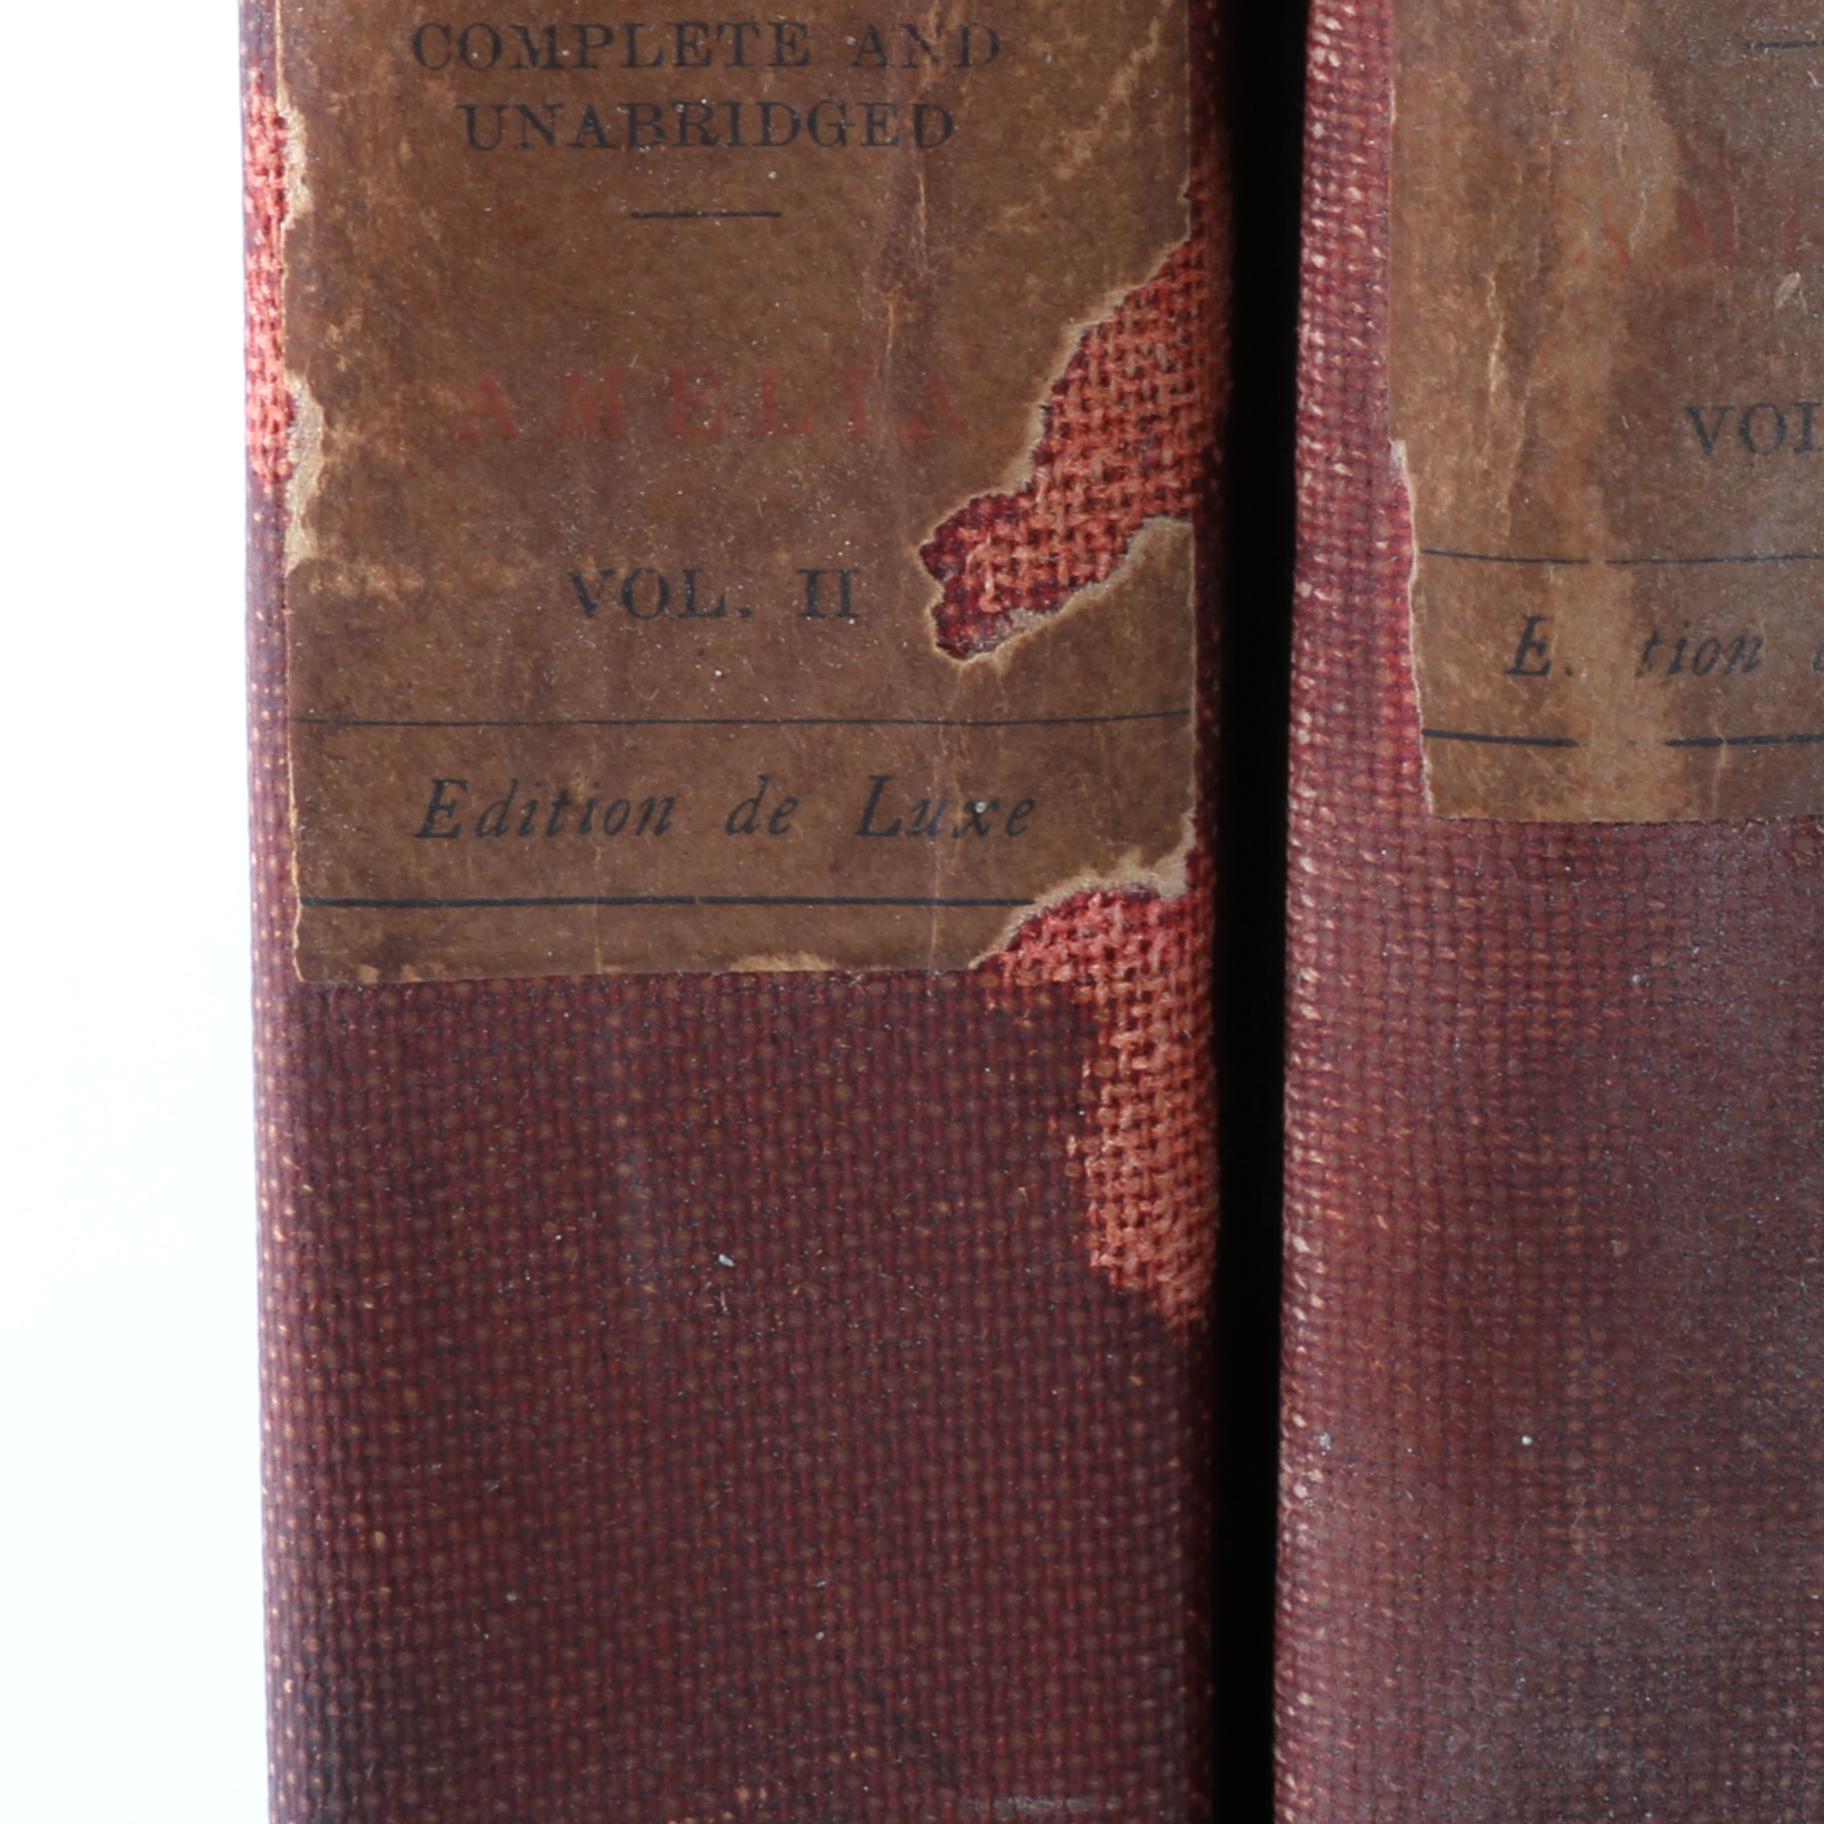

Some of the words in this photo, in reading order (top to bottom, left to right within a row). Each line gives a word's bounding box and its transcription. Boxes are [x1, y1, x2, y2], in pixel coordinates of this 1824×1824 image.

[411, 21, 810, 71] COMPLETE
[848, 21, 1004, 70] AND
[457, 101, 956, 150] UNABRIDGED
[566, 567, 754, 620] VOL.
[798, 568, 861, 620] II
[1506, 614, 1766, 678] Etion
[414, 776, 677, 839] Edition
[724, 774, 799, 837] de
[854, 775, 1037, 839] Luxe
